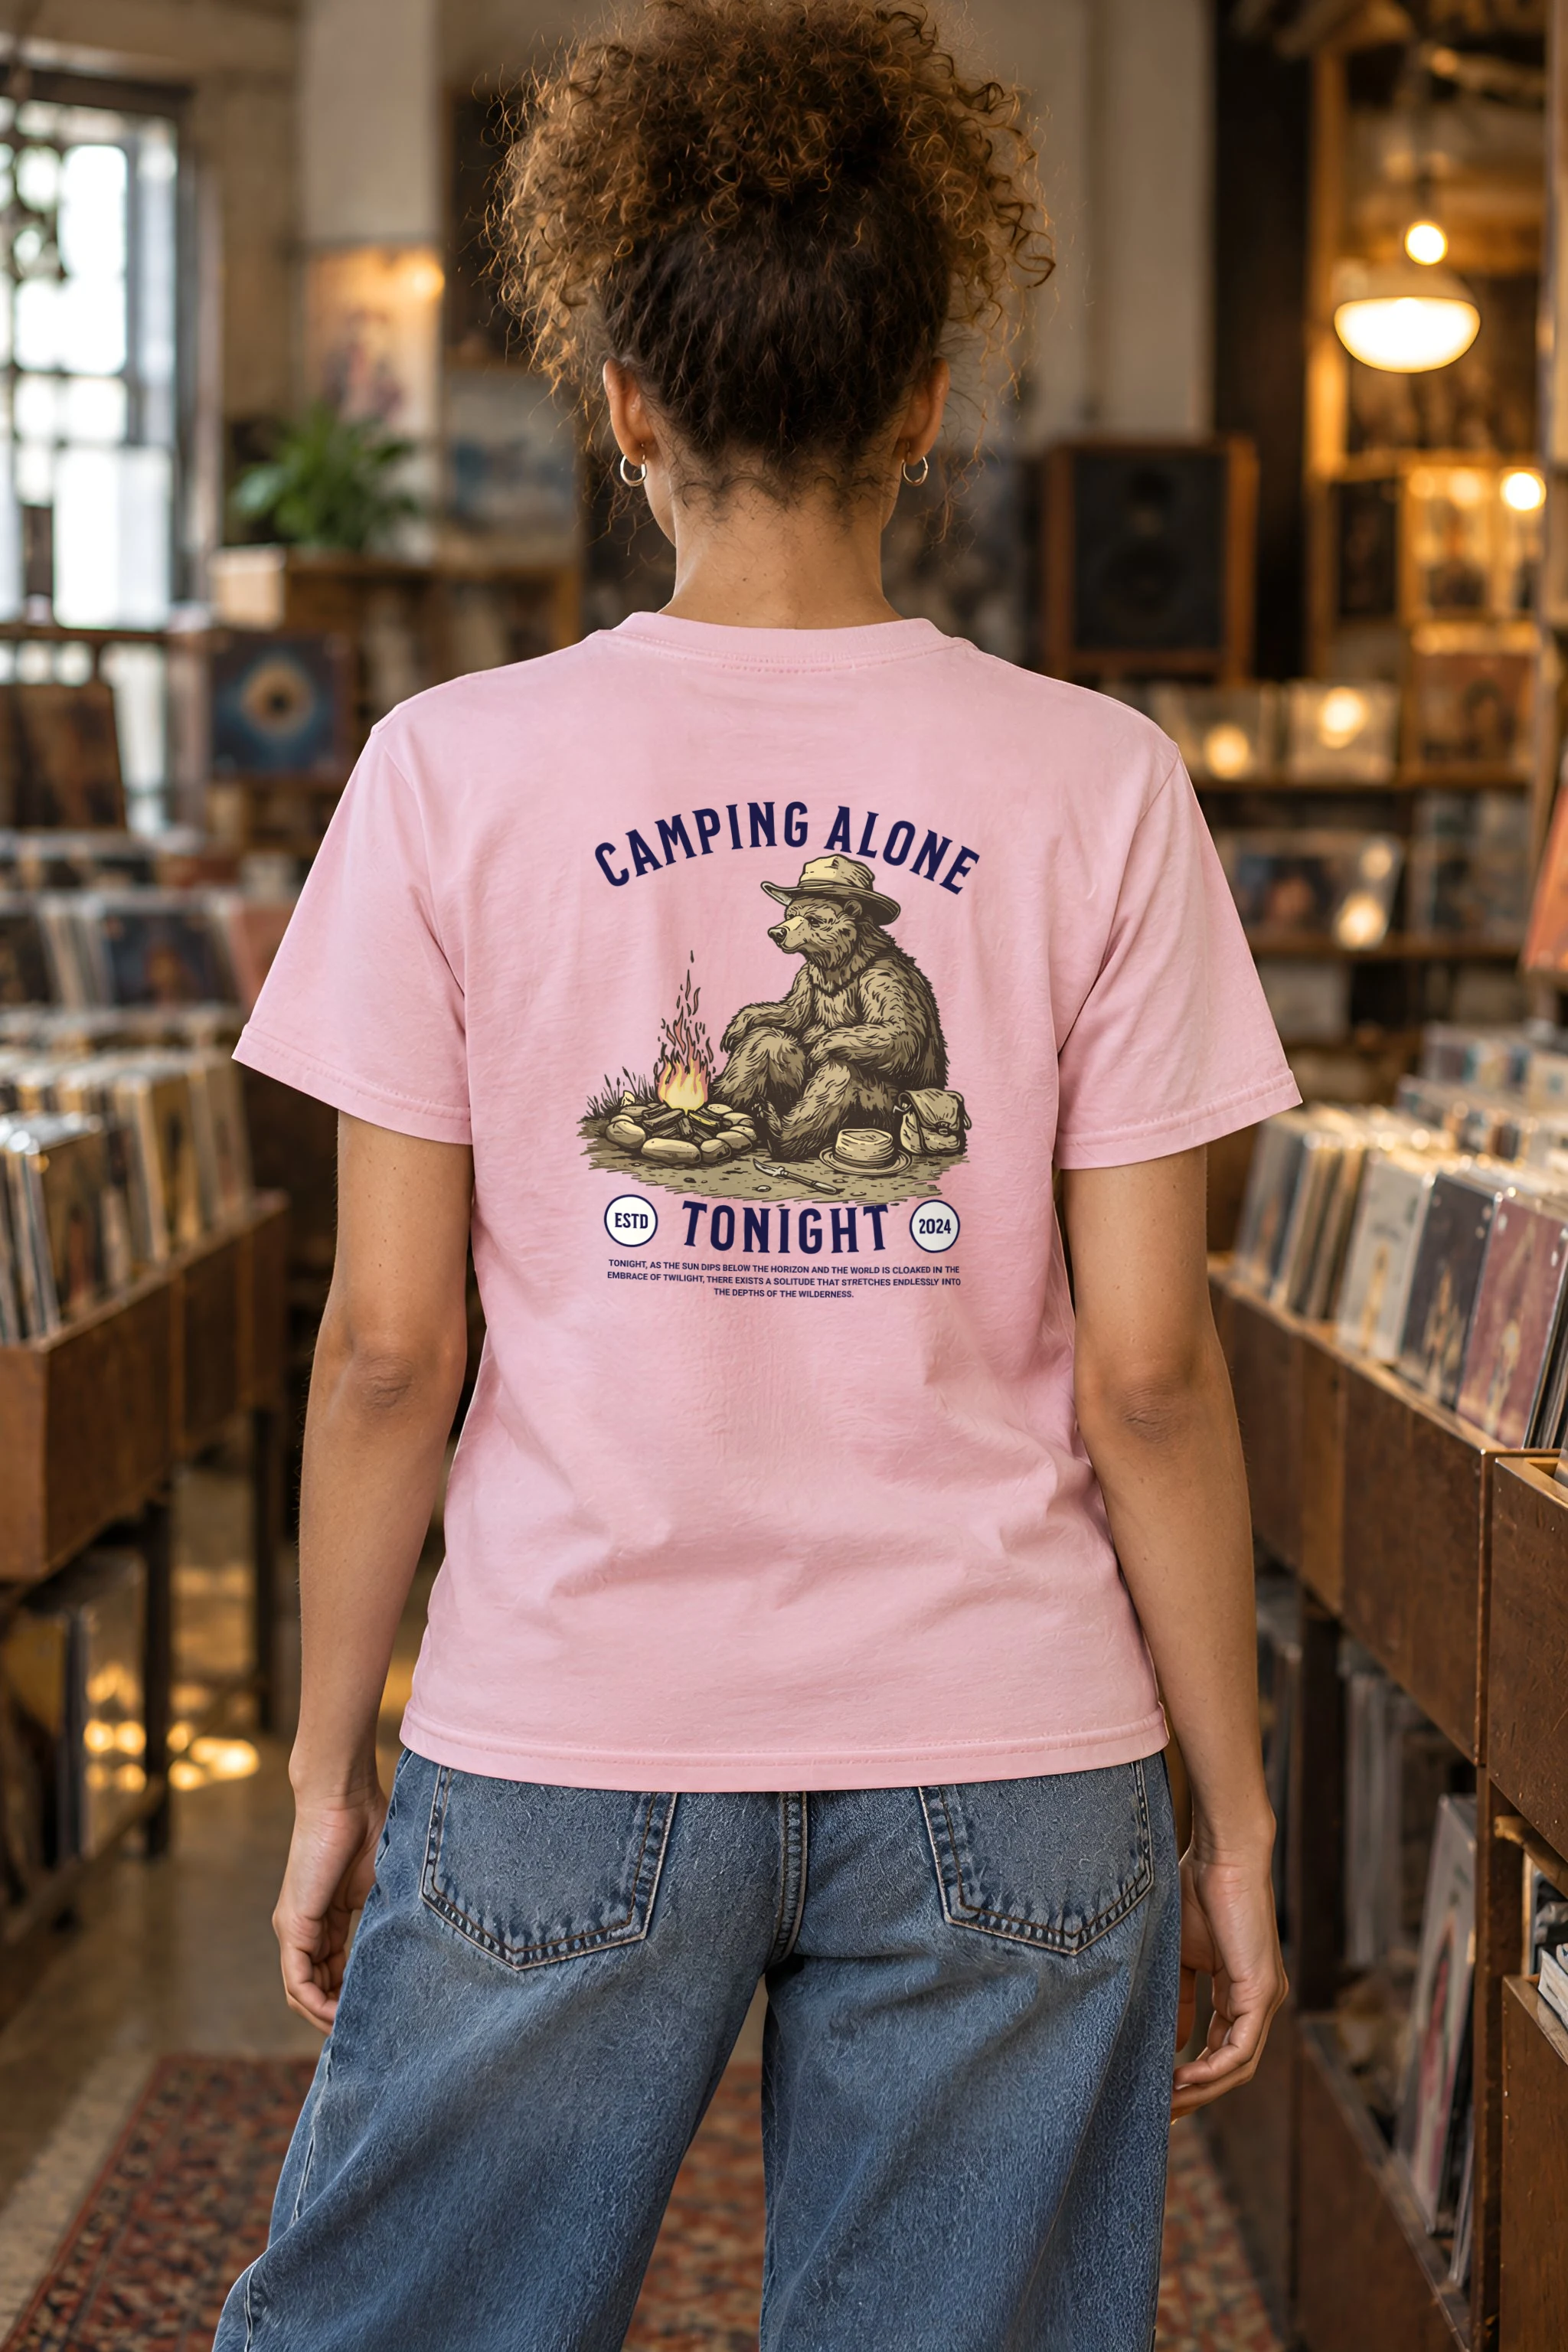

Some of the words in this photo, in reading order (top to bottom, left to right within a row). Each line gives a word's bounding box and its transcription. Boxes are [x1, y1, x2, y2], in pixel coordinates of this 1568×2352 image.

[595, 802, 808, 887] CAMPING
[825, 806, 980, 894] ALONE
[614, 1212, 648, 1230] ESTD
[682, 1200, 889, 1254] TONIGHT
[919, 1219, 951, 1234] 2024
[609, 1259, 648, 1269] TONIGHT,
[701, 1263, 720, 1272] DIPS
[607, 1271, 648, 1280] EMBRACE
[663, 1274, 704, 1284] TWILIGHT,
[706, 1276, 733, 1284] THERE
[735, 1276, 764, 1285] EXISTS
[841, 1278, 891, 1286] STRETCHES
[893, 1278, 939, 1286] ENDLESSLY
[714, 1288, 730, 1296] THE
[732, 1289, 765, 1297] DEPTHS
